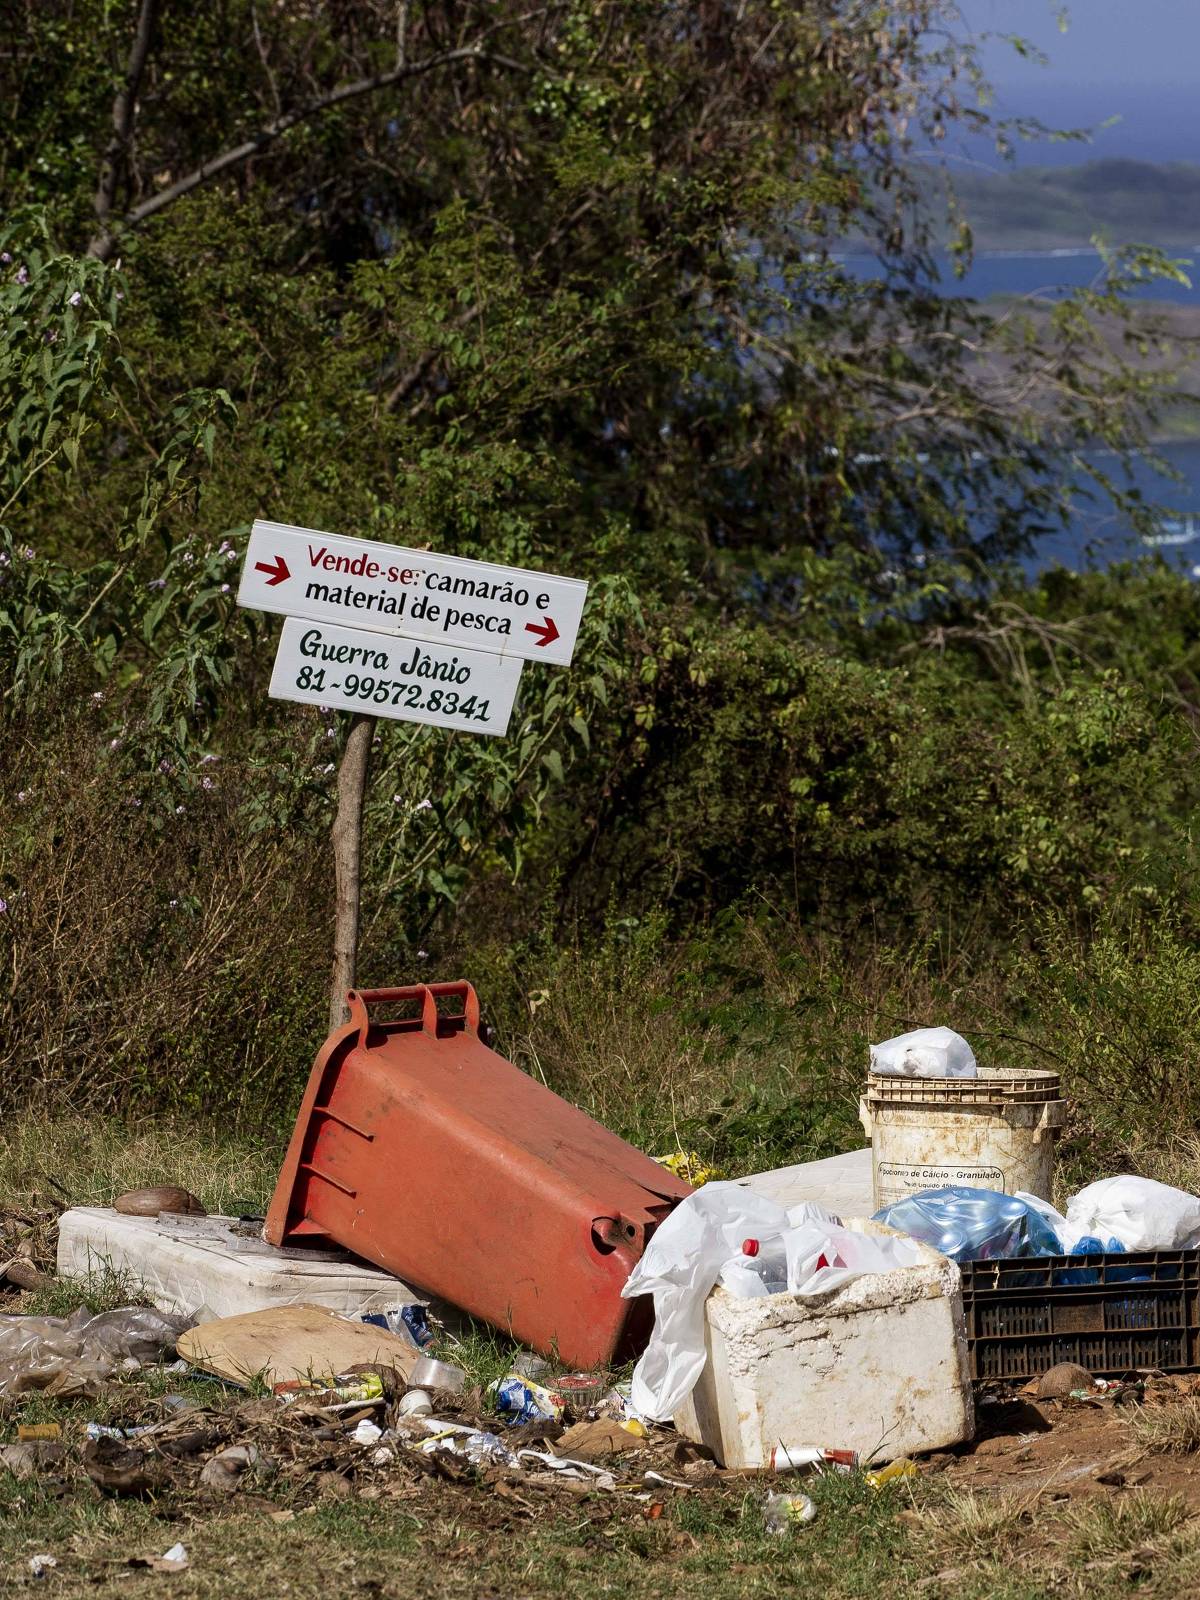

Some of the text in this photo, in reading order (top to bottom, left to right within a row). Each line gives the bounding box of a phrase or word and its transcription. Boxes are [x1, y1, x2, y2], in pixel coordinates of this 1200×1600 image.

[305, 582, 512, 635] material de pesca
[425, 572, 529, 606] camarão
[535, 593, 550, 609] e
[300, 629, 471, 685] Guerra Jânio
[295, 665, 491, 722] 81-99572.8341
[922, 1170, 949, 1178] Cálcio
[957, 1171, 1001, 1179] Granulado
